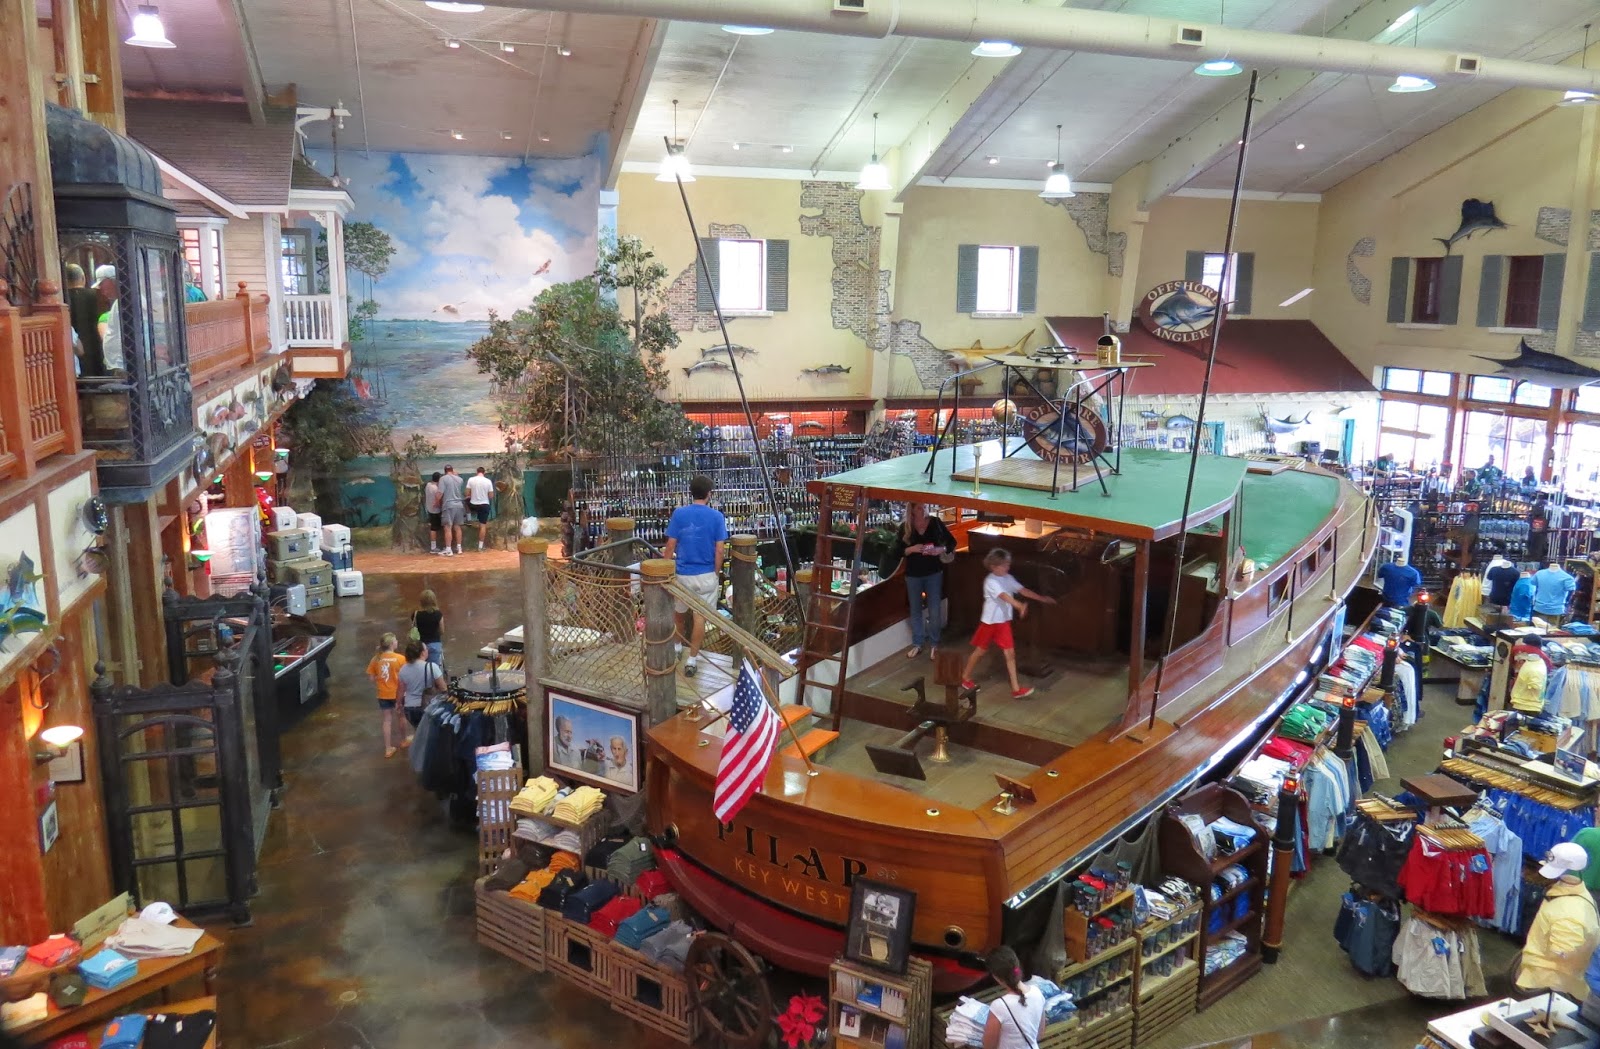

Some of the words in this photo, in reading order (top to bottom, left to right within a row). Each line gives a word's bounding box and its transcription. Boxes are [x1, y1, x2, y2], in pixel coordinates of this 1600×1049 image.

[1152, 327, 1210, 342] ANGLER
[1029, 401, 1100, 427] OFFSHRE
[735, 857, 770, 884] KEY
[782, 876, 848, 909] WEST
